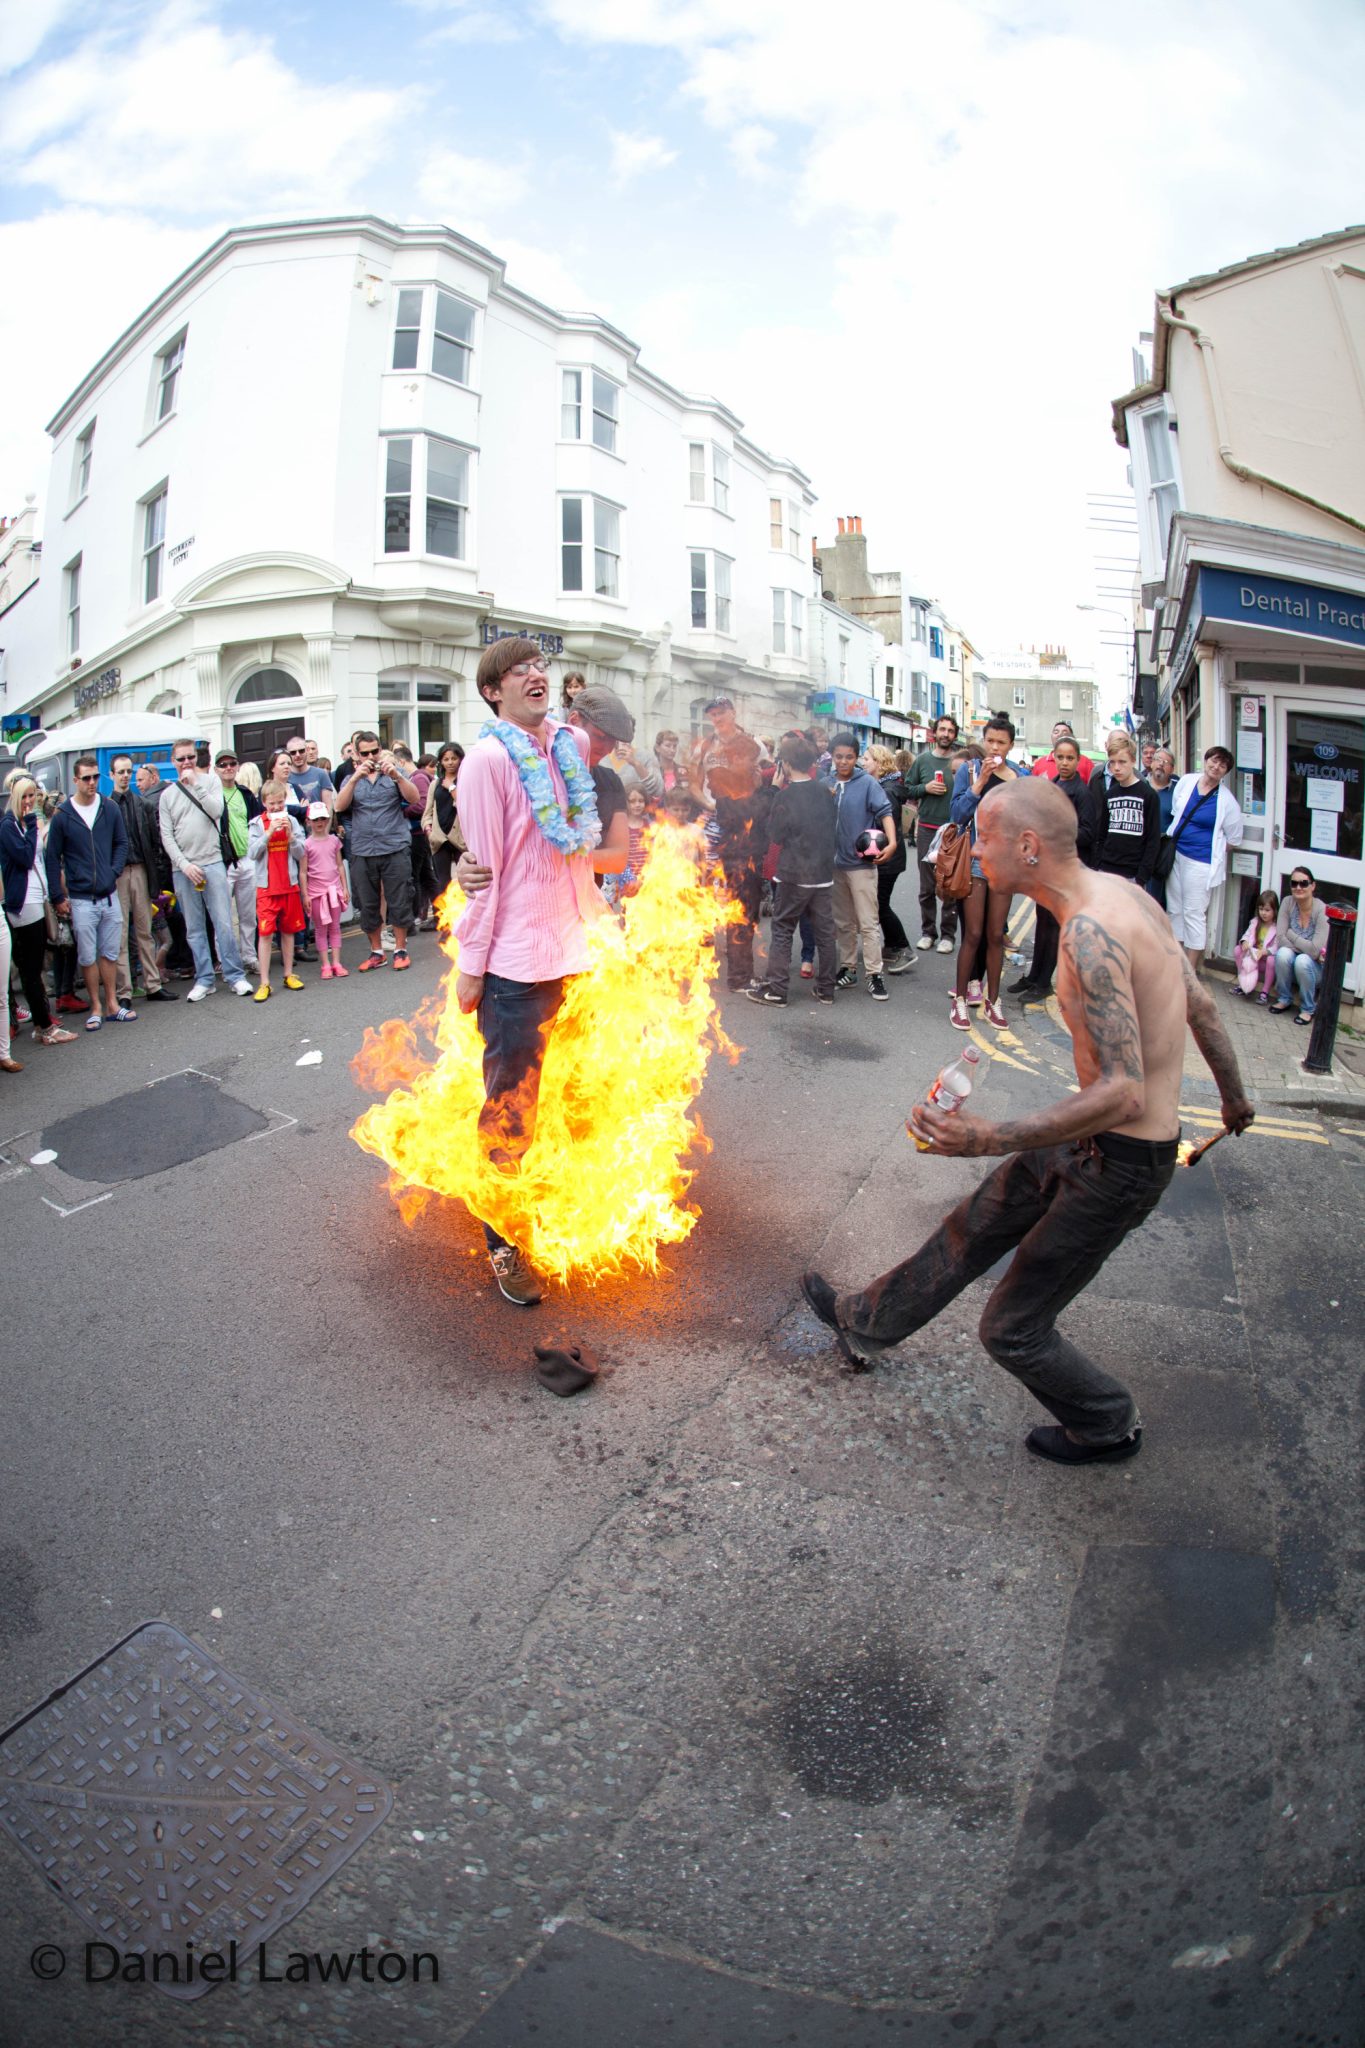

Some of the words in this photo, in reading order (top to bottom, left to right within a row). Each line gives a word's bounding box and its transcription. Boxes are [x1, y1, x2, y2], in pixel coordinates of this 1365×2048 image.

[1240, 587, 1310, 618] Dental
[539, 632, 564, 653] TSB
[1319, 745, 1335, 758] 109
[1294, 762, 1359, 783] WELCOME
